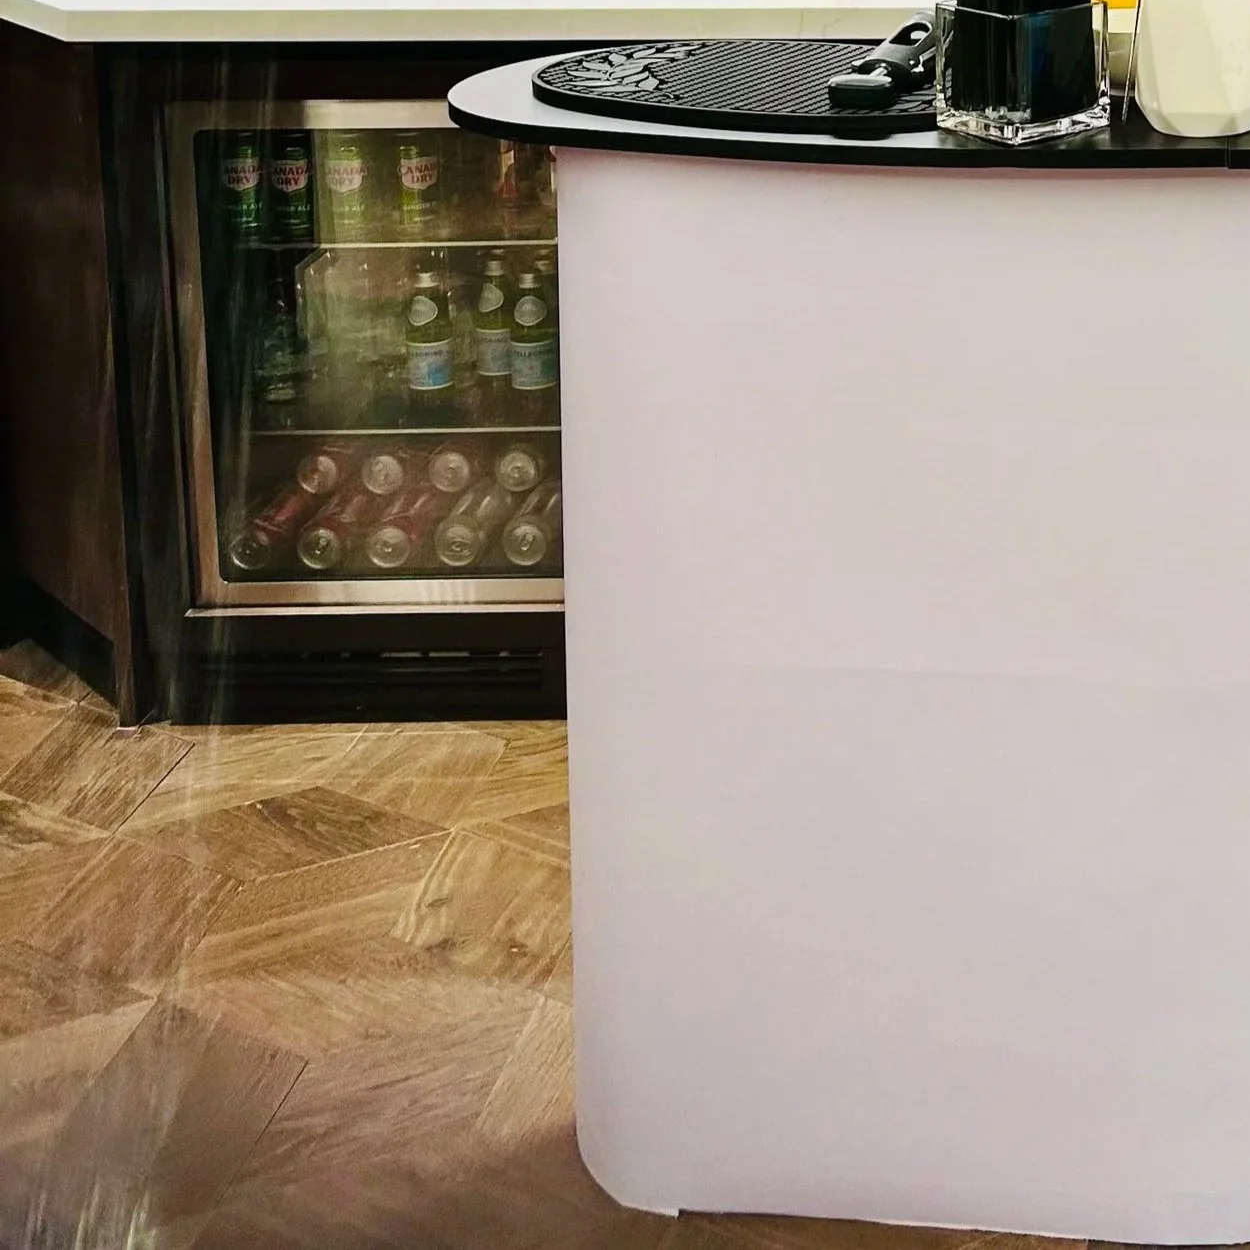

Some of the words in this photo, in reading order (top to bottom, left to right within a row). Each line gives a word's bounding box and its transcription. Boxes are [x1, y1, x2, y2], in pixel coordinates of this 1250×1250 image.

[227, 175, 252, 185] DRY
[277, 176, 300, 186] DRY
[411, 173, 433, 184] DRY
